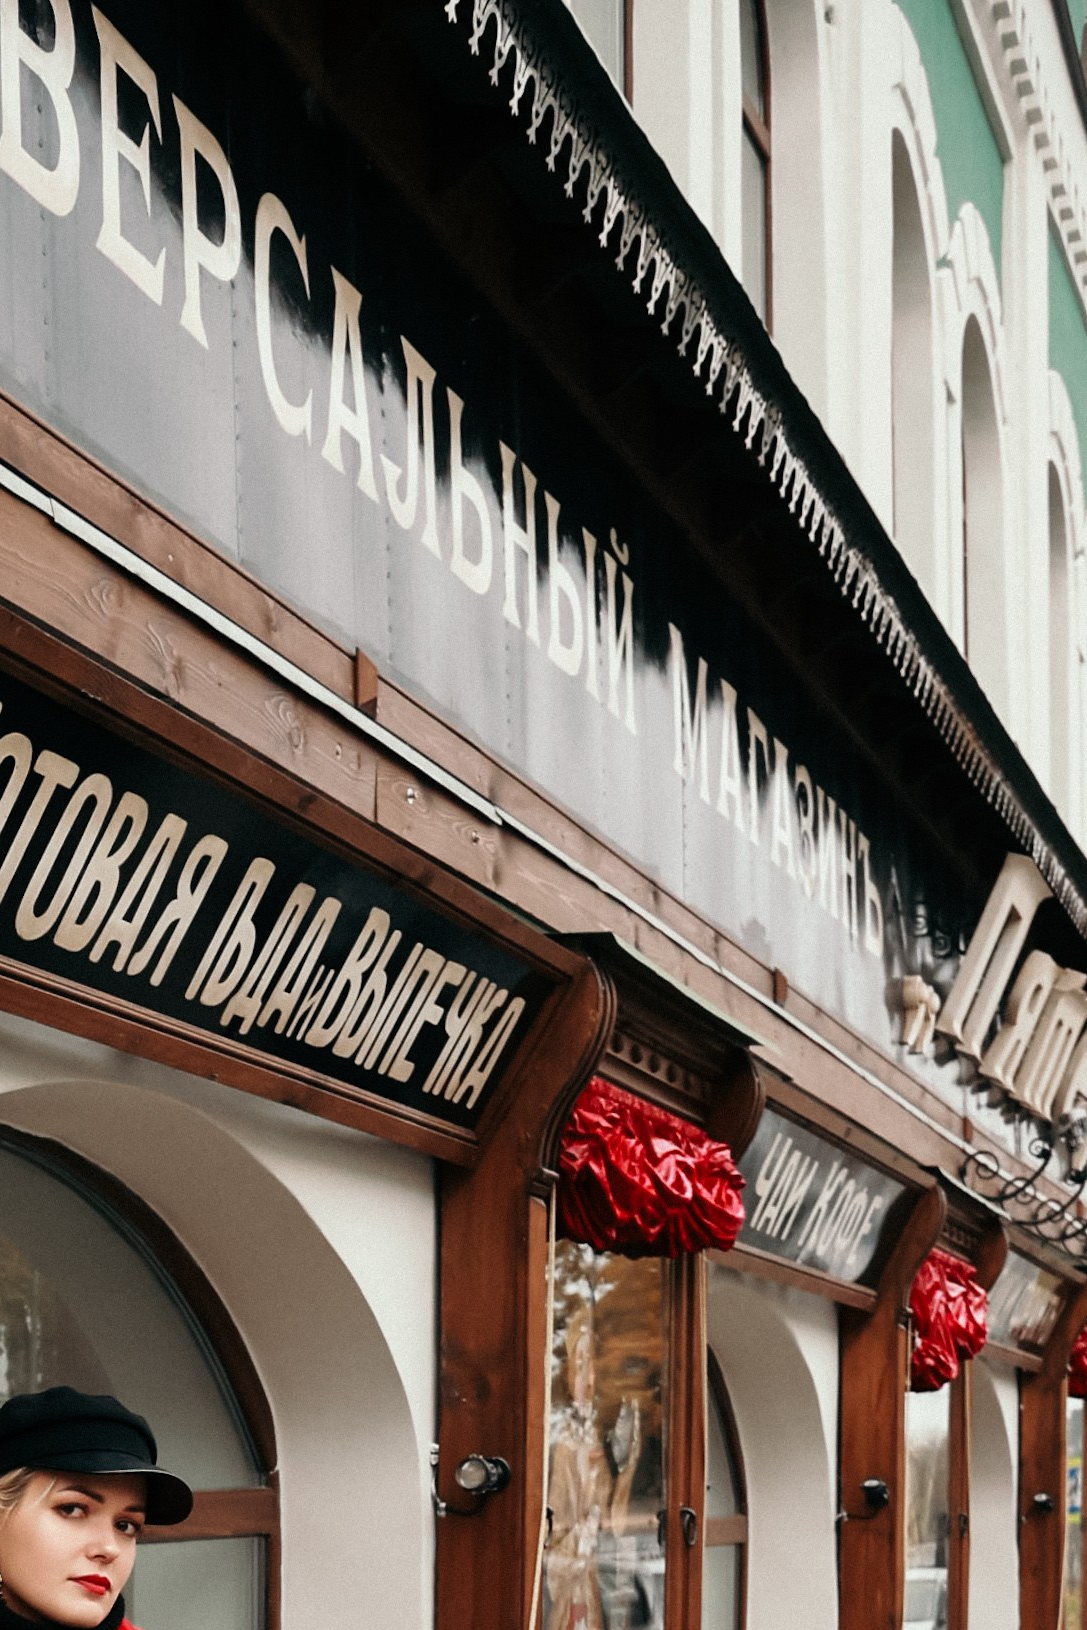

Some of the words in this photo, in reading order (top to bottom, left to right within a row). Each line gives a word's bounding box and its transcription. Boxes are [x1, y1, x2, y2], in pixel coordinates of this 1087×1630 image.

[668, 621, 884, 958] МАГАЗИНЪ
[303, 906, 526, 1110] ВЫПЕЧКА
[797, 1161, 883, 1265] КОФЕ
